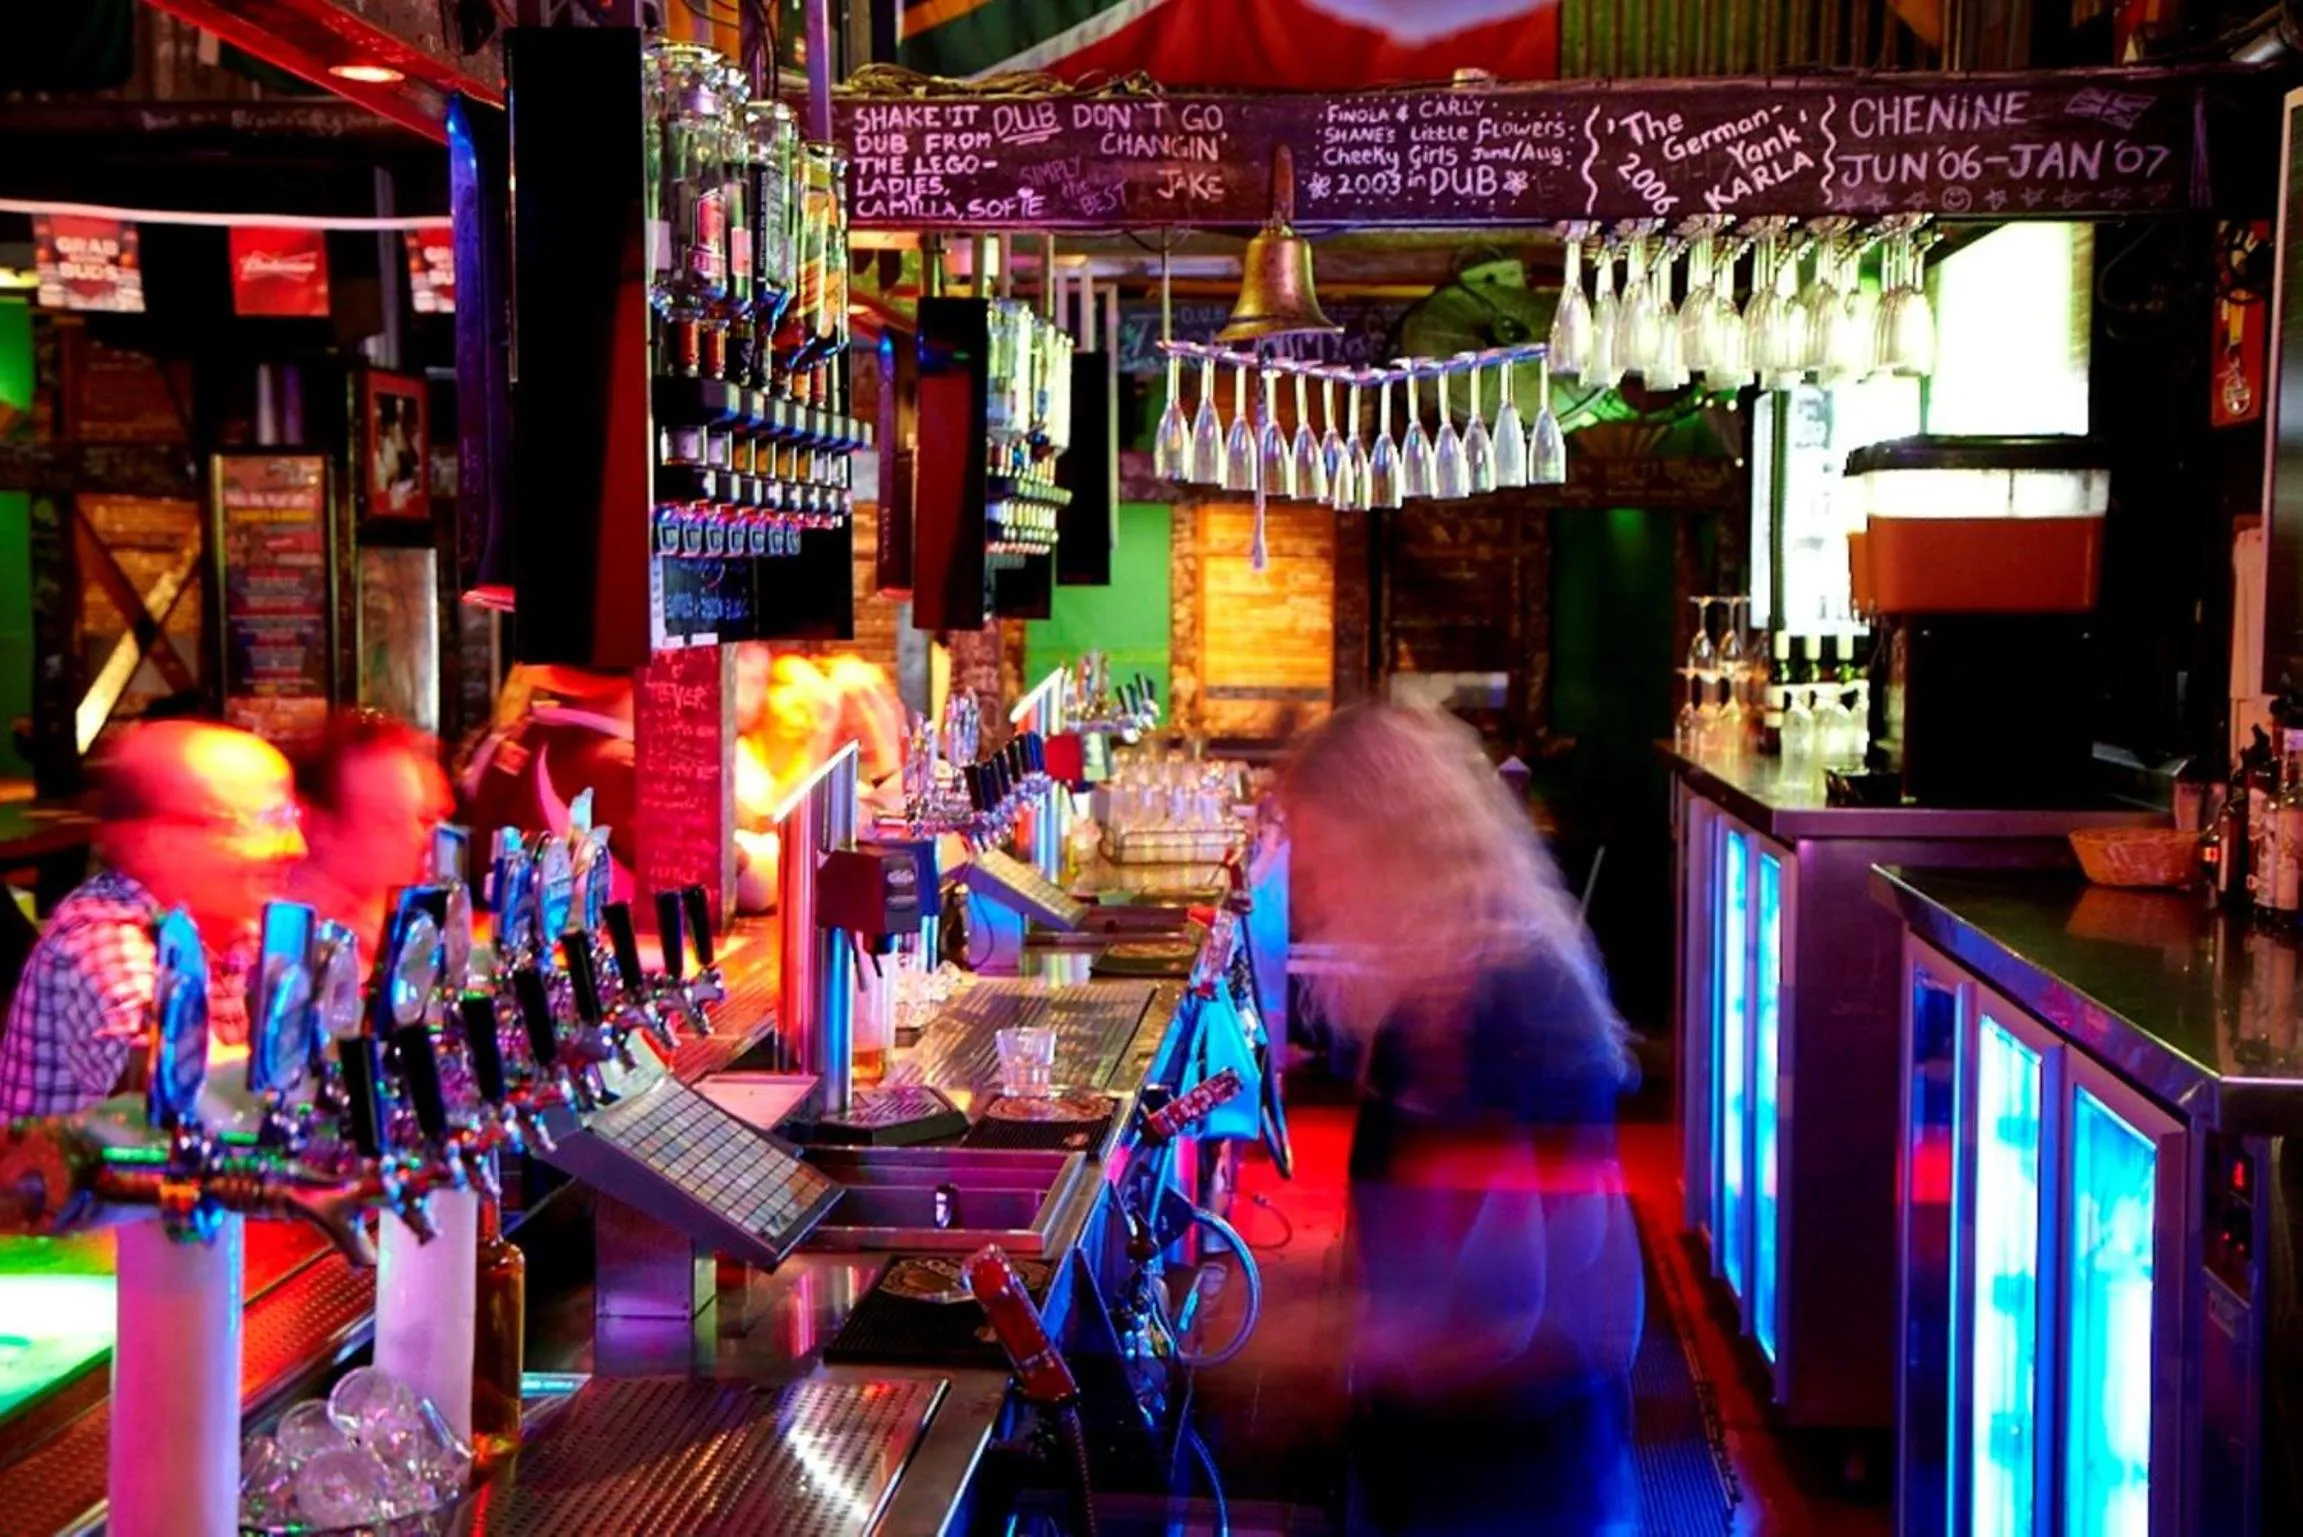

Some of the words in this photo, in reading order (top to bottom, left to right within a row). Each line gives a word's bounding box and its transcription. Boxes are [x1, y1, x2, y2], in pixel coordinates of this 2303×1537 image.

[854, 104, 942, 135] SHAKE
[1182, 105, 1223, 131] GO
[1419, 98, 1484, 118] CARLY
[855, 133, 909, 154] DUB
[925, 131, 992, 154] FROM
[853, 156, 905, 176] THE
[1337, 173, 1401, 196] 2003
[1408, 169, 1428, 187] in
[1430, 165, 1498, 196] DUB
[1703, 151, 1814, 212] KARLA
[1836, 152, 1928, 187] JUN
[1617, 153, 1680, 215] 2006
